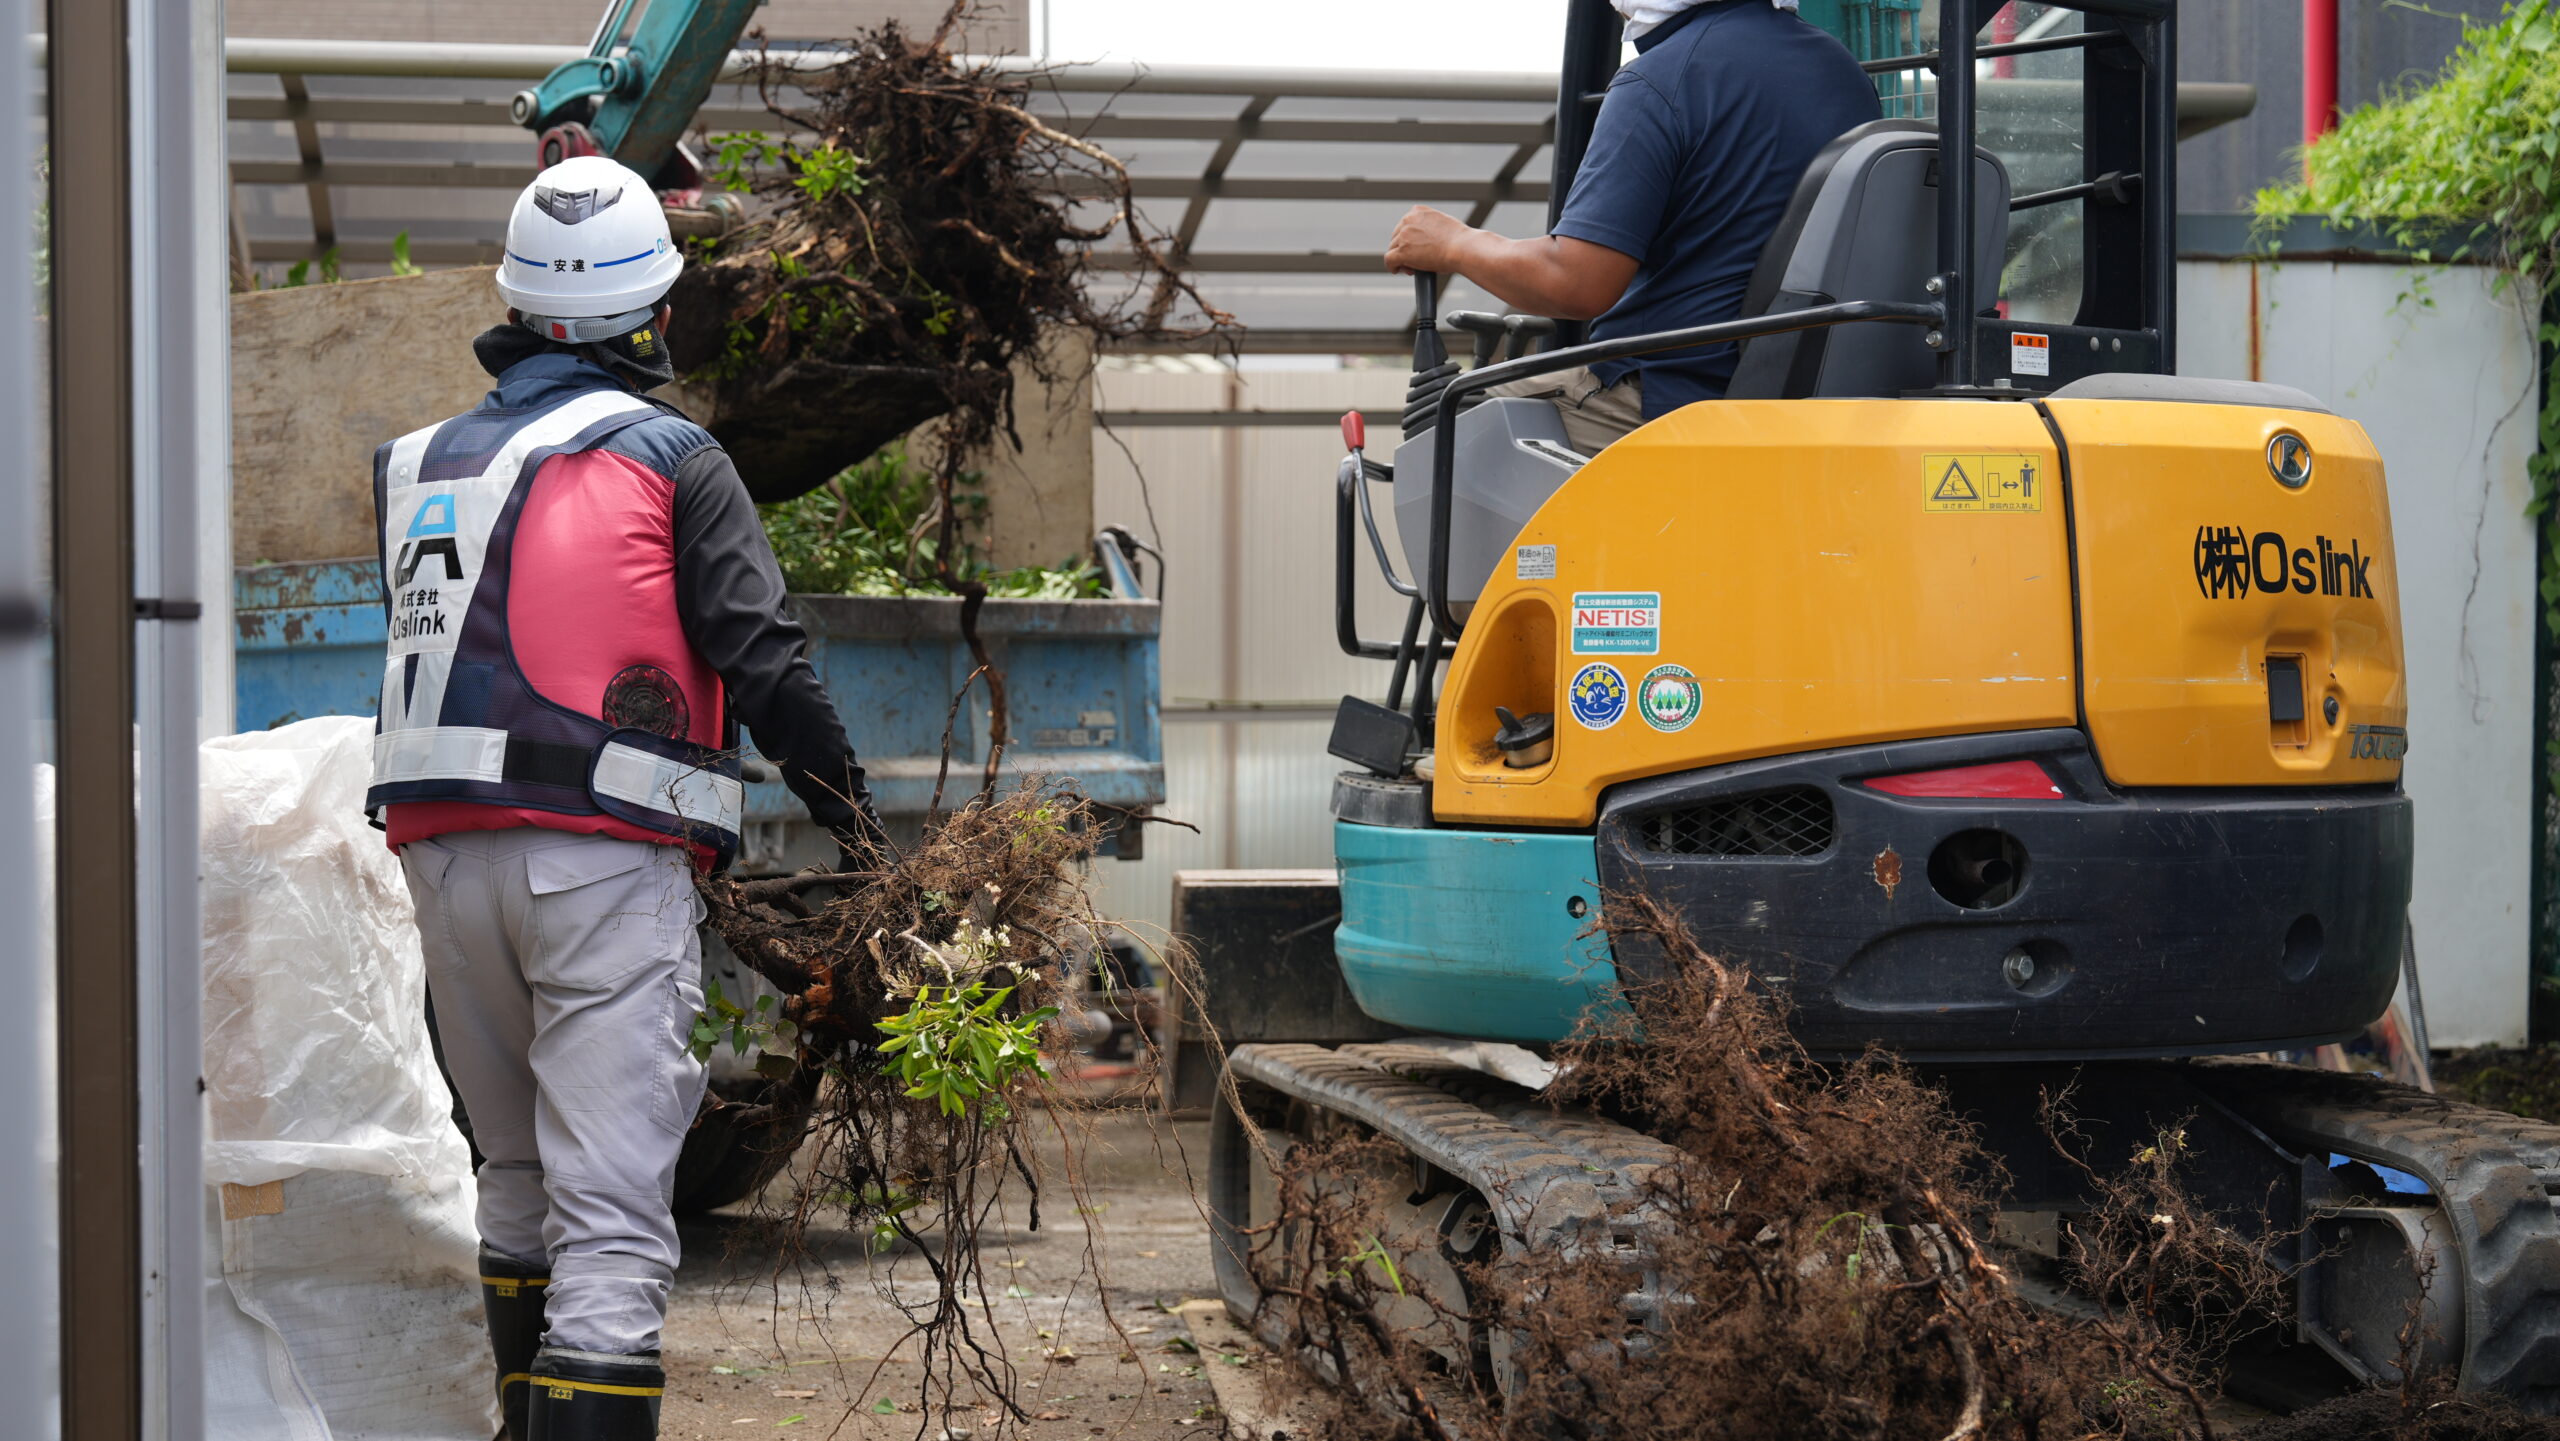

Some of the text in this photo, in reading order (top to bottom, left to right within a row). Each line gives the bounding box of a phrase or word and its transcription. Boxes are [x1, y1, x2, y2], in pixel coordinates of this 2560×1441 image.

[554, 259, 586, 273] 安達
[393, 609, 446, 640] Oslink
[1578, 609, 1647, 626] NETIS
